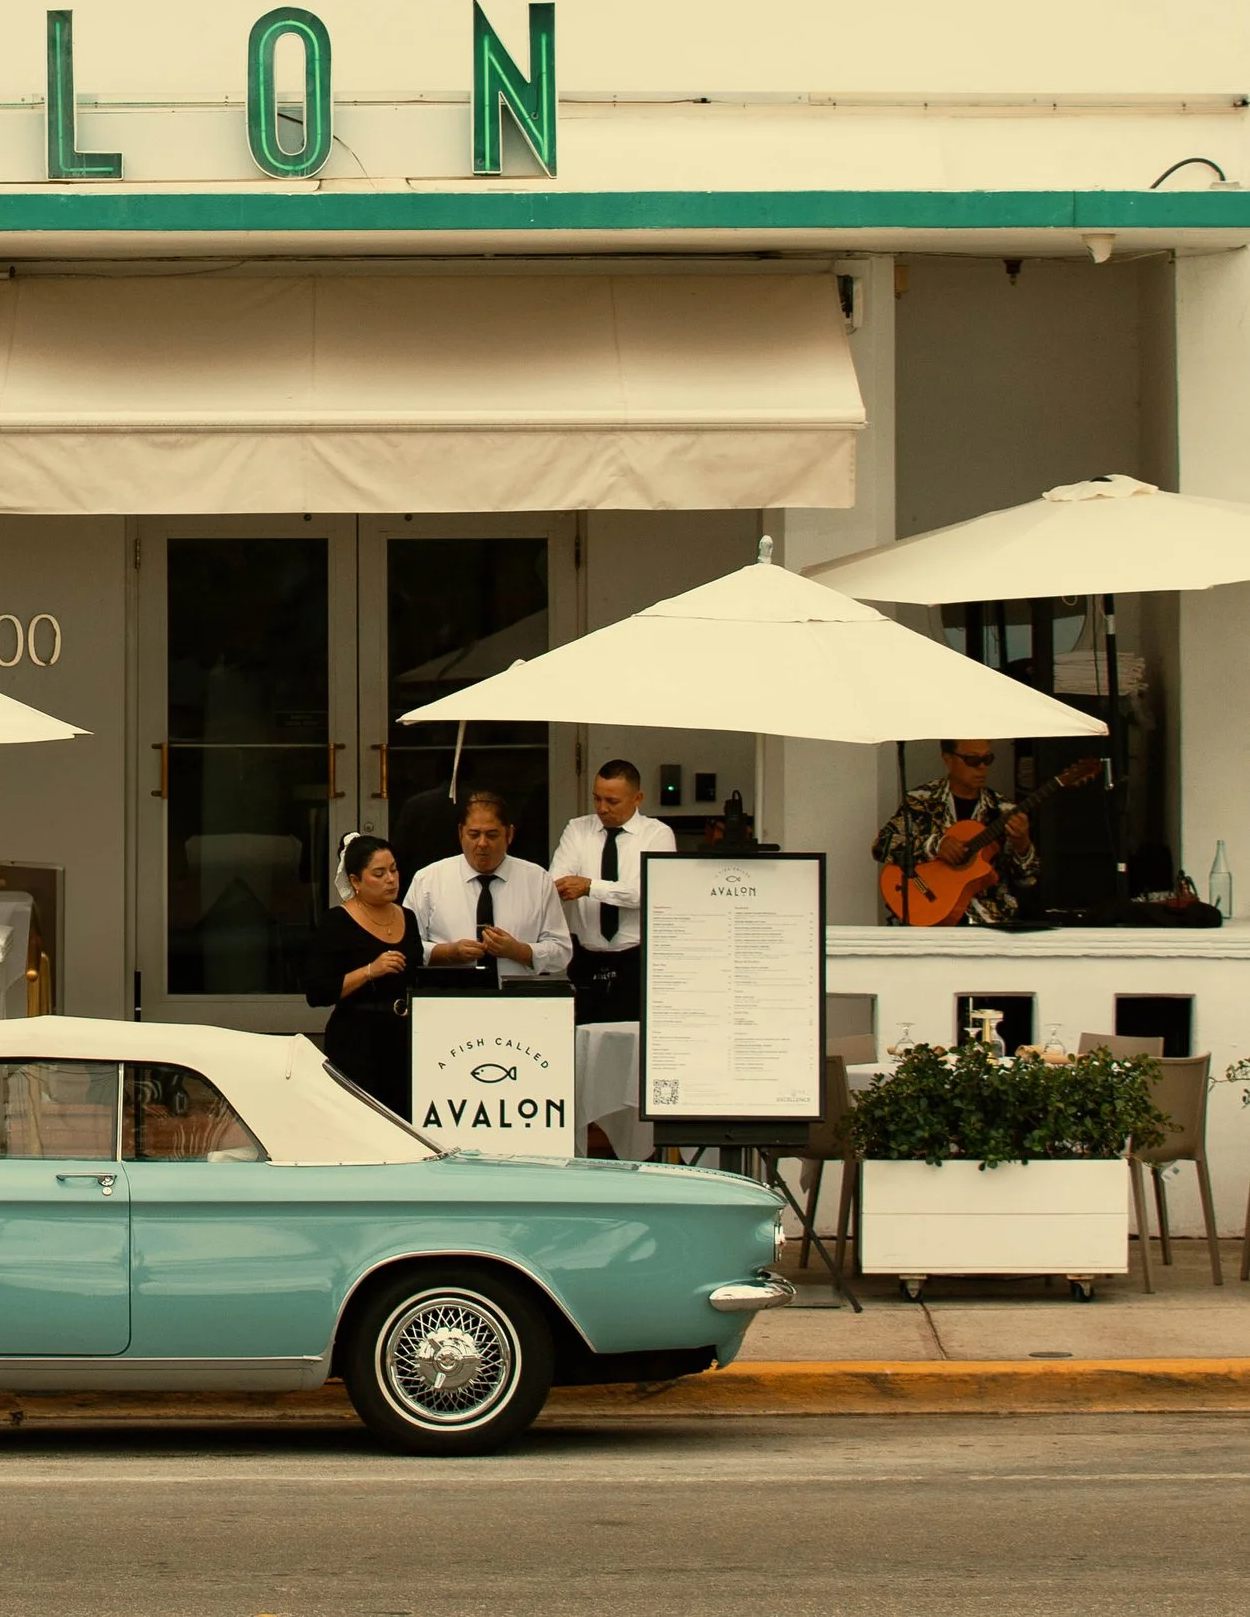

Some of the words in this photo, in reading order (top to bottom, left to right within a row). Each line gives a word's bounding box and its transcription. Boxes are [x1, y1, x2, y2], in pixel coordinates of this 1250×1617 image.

[710, 886, 757, 897] AVALON
[437, 1061, 447, 1070] A
[450, 1038, 485, 1058] FISH
[495, 1037, 549, 1070] CALLED
[422, 1098, 565, 1128] AVALON
